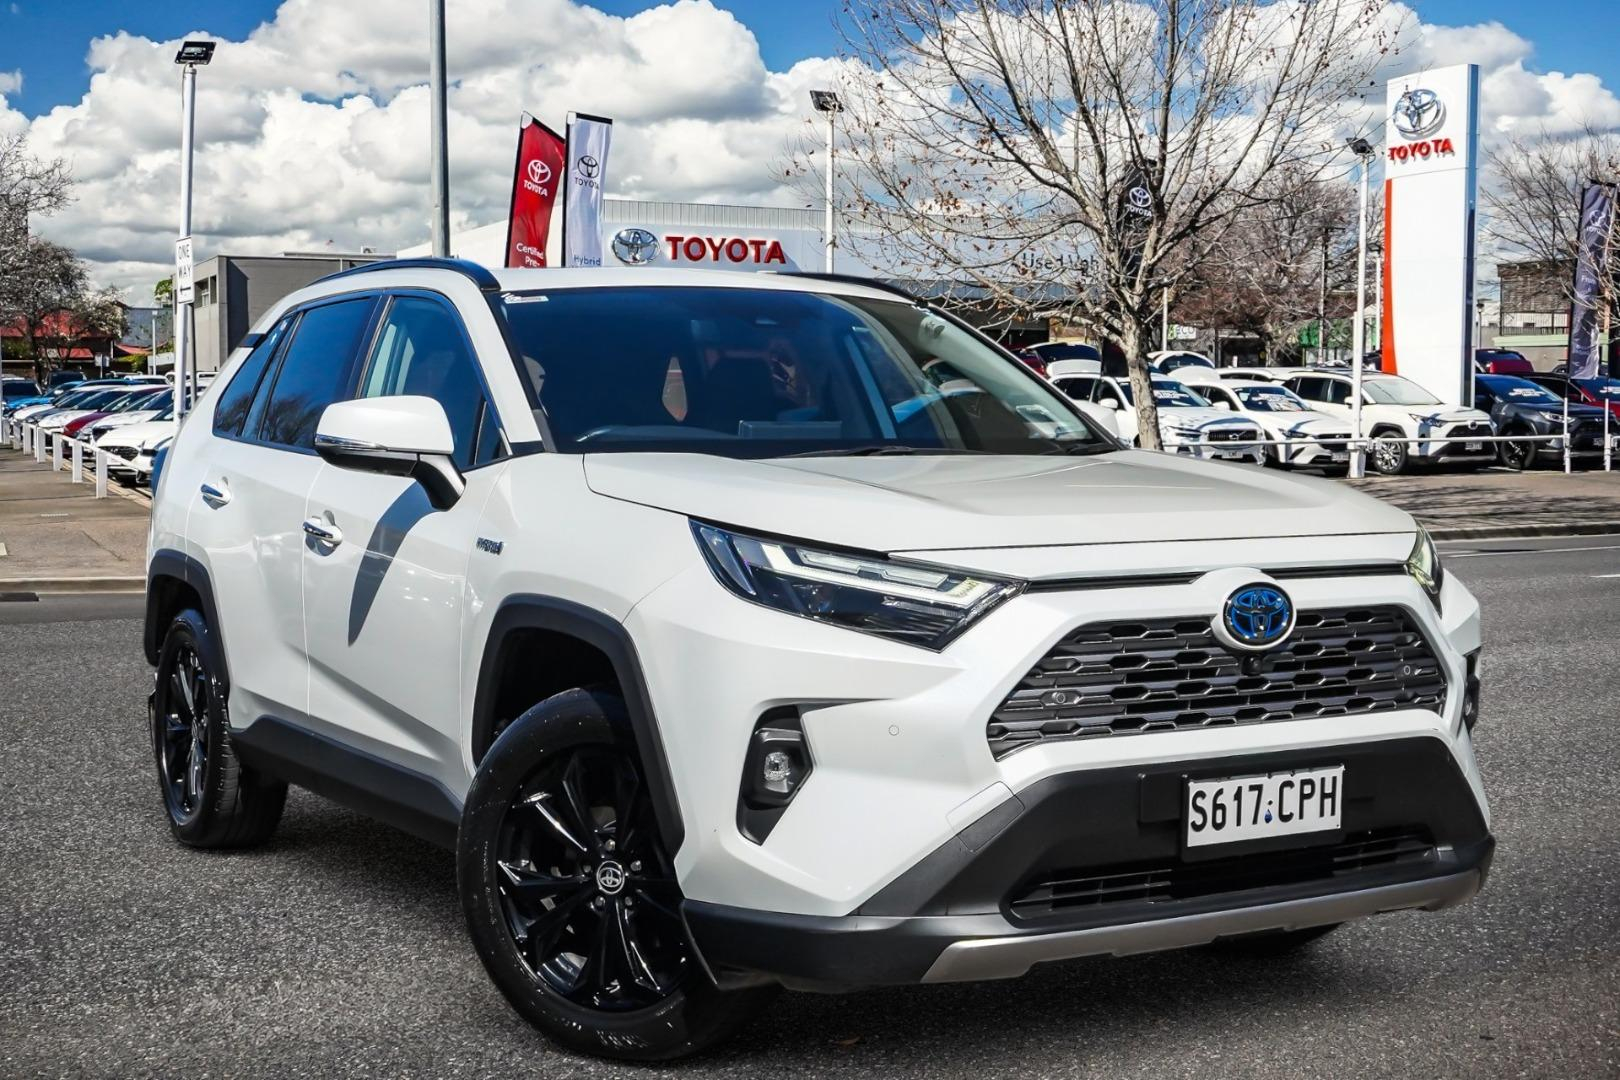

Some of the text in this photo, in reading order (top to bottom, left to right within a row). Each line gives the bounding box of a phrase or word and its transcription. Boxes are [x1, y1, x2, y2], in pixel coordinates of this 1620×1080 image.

[1388, 138, 1454, 161] TOYOTA
[524, 180, 548, 197] TOYOTA
[575, 177, 599, 189] TOYOTA
[1125, 204, 1152, 217] TOYOTA
[178, 243, 190, 260] ONE
[516, 242, 544, 260] Certified
[665, 235, 787, 265] TOYOTA
[574, 254, 601, 266] Hybrid
[178, 265, 191, 279] WAY
[1278, 775, 1338, 823] CPH
